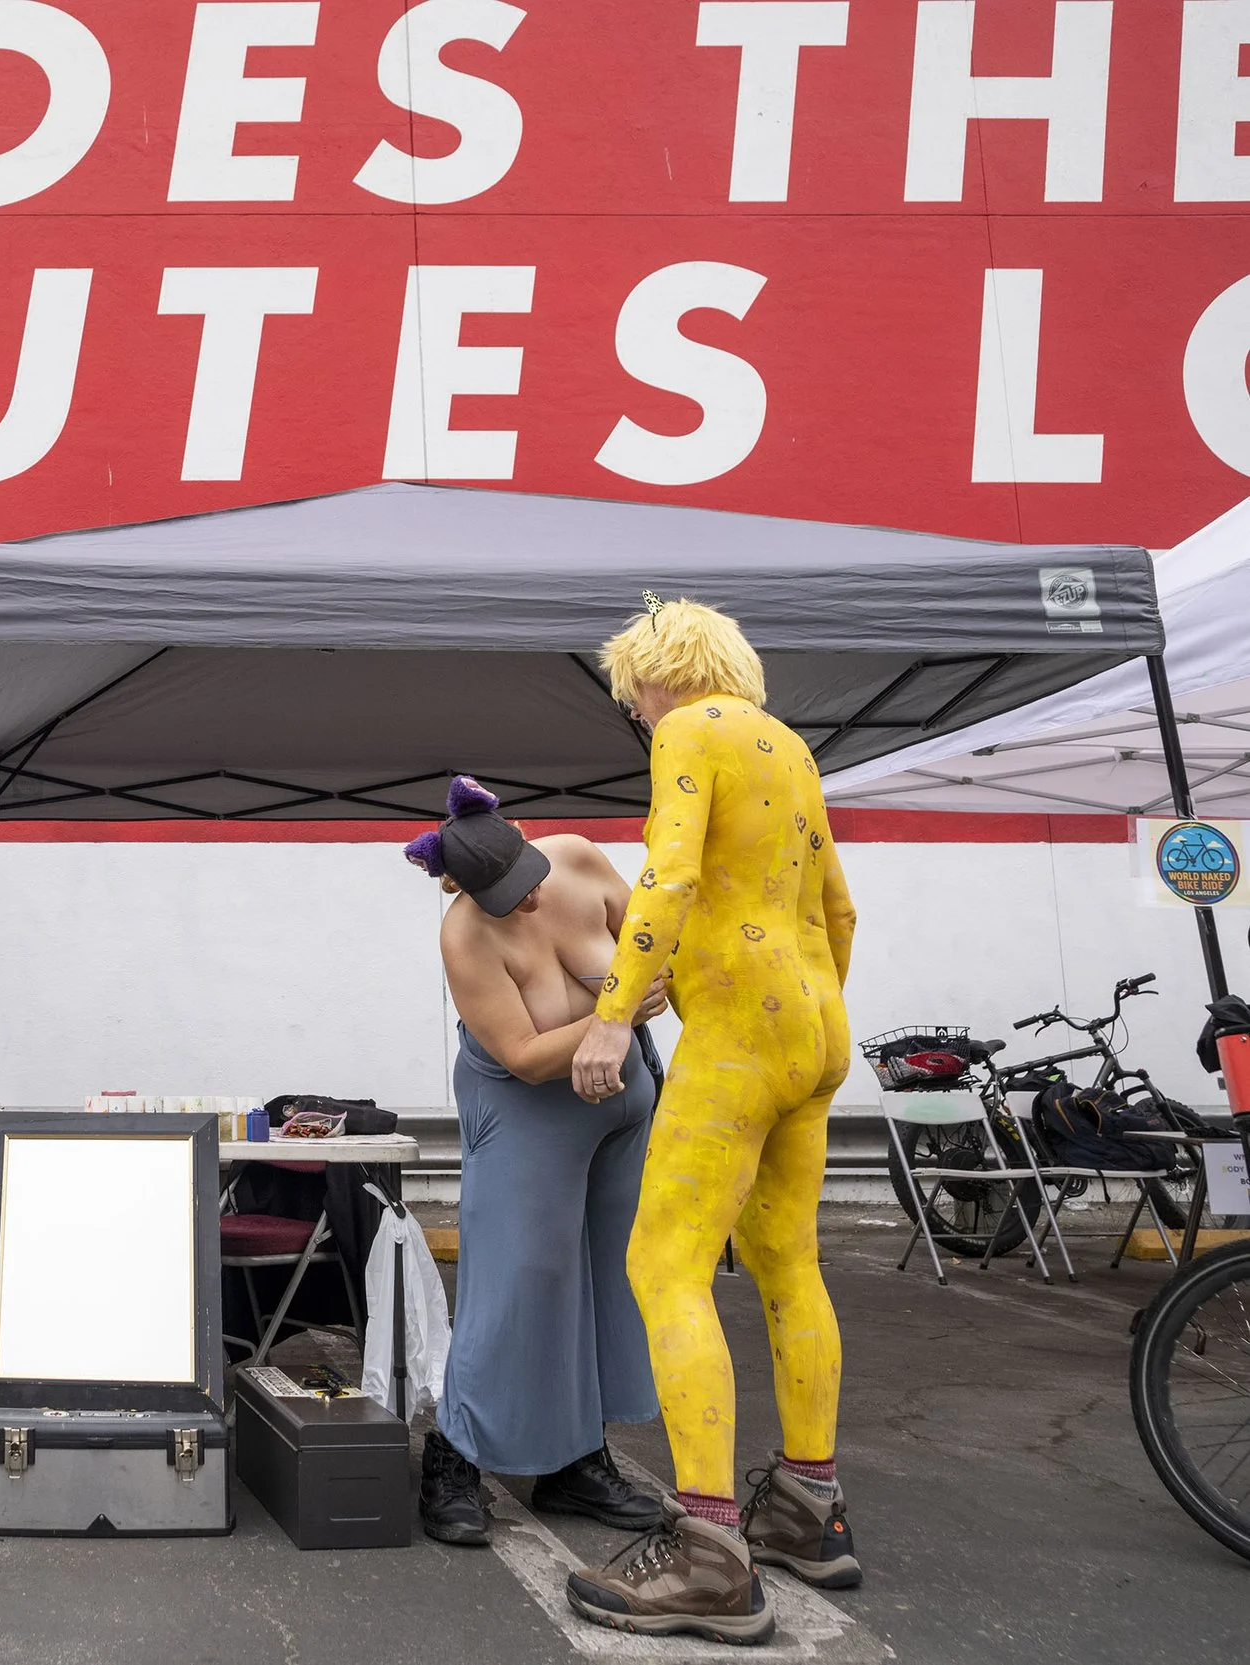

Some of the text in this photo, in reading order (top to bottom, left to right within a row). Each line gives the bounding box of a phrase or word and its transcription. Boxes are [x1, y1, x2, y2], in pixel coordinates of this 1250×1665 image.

[696, 0, 1250, 203] THE
[1168, 871, 1231, 881] WORLD NAKED
[1177, 880, 1225, 890] BIKE RIDE
